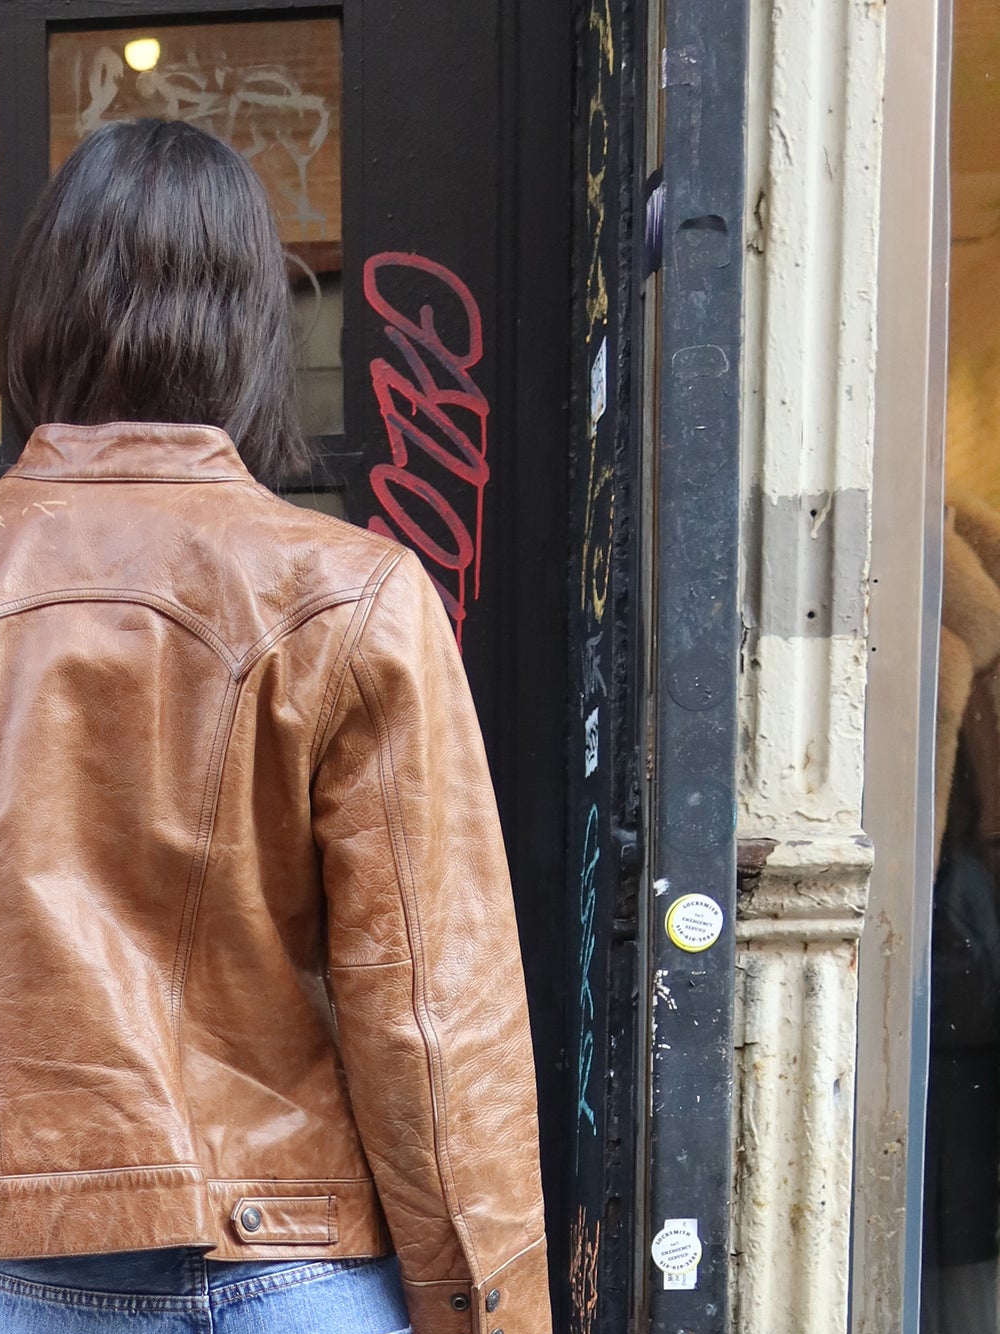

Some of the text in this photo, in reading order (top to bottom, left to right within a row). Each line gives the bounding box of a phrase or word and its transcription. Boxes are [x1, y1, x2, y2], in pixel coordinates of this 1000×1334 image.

[683, 900, 719, 916] LOCKSMITH
[682, 917, 713, 927] EMERGENCY
[685, 924, 706, 933] SERVICE
[655, 1229, 691, 1245] LOCKSMITH
[661, 1244, 691, 1256] EMERGENCY
[668, 1252, 689, 1262] SERVICE
